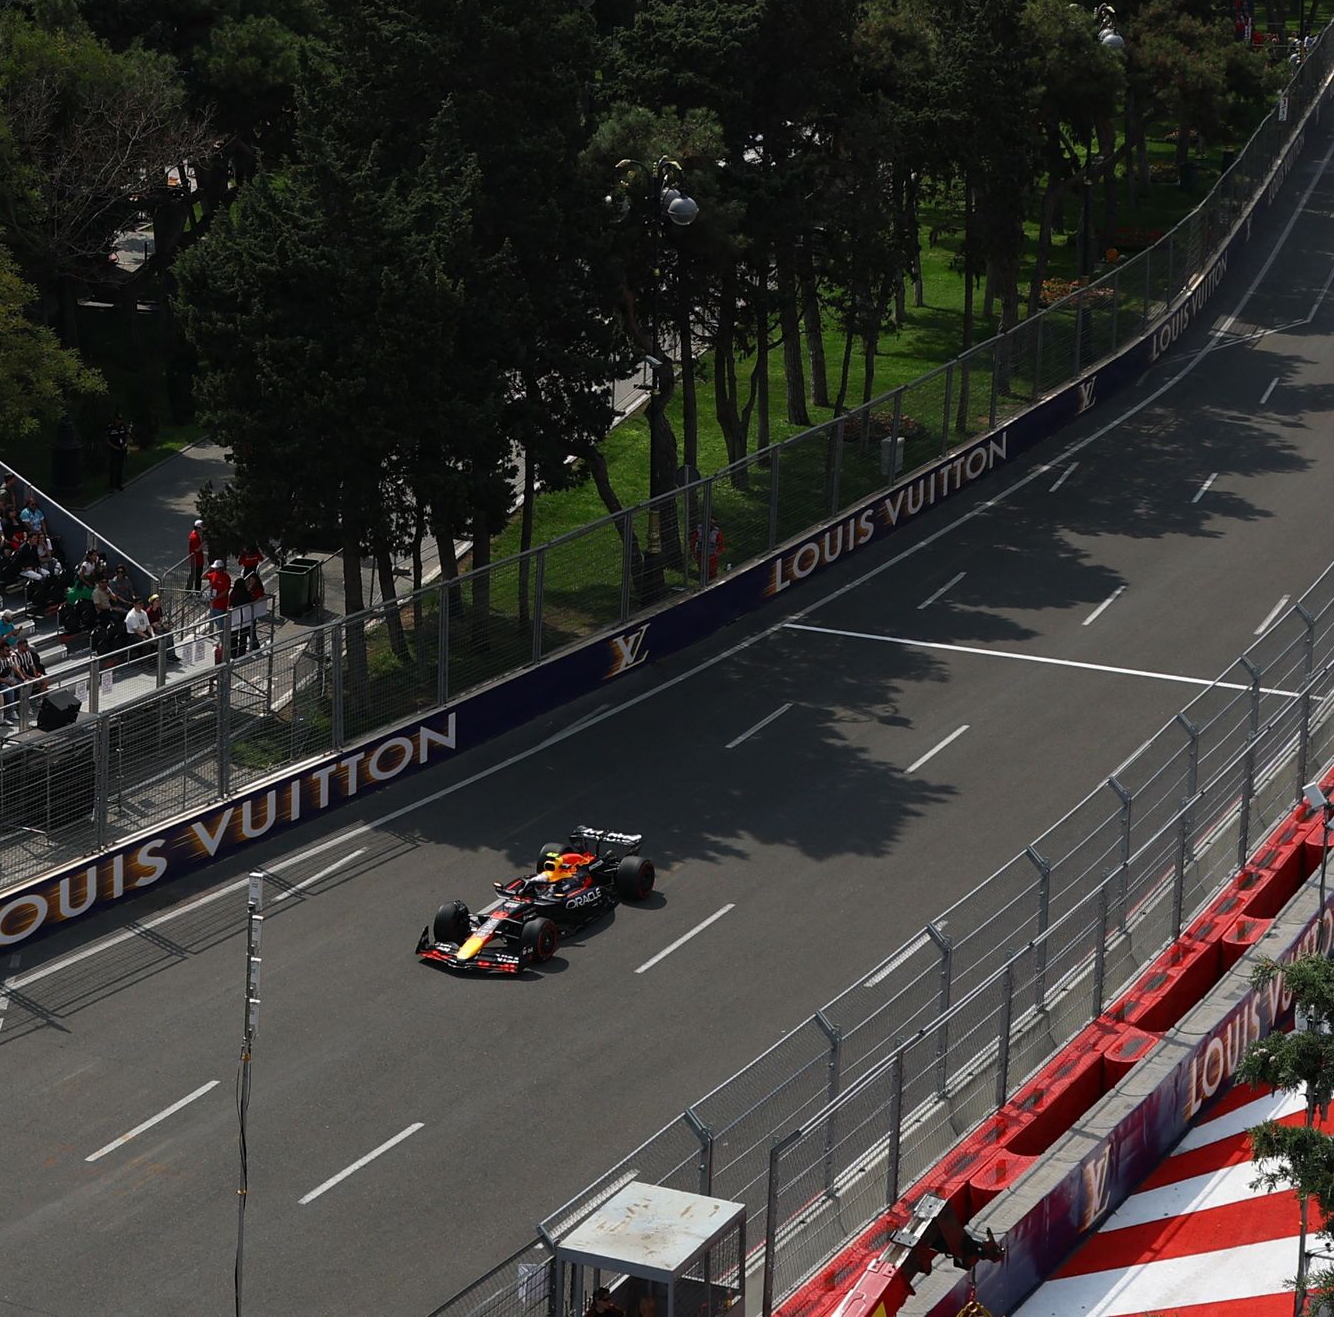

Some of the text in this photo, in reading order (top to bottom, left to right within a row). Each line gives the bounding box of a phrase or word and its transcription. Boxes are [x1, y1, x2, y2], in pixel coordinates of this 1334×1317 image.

[1153, 250, 1228, 361] LOUIS VUITTON
[775, 432, 1007, 592] LOUIS VUITTON
[191, 712, 458, 858] VUITTON
[565, 887, 602, 909] ORACLE
[1190, 992, 1261, 1117] LOUIS
